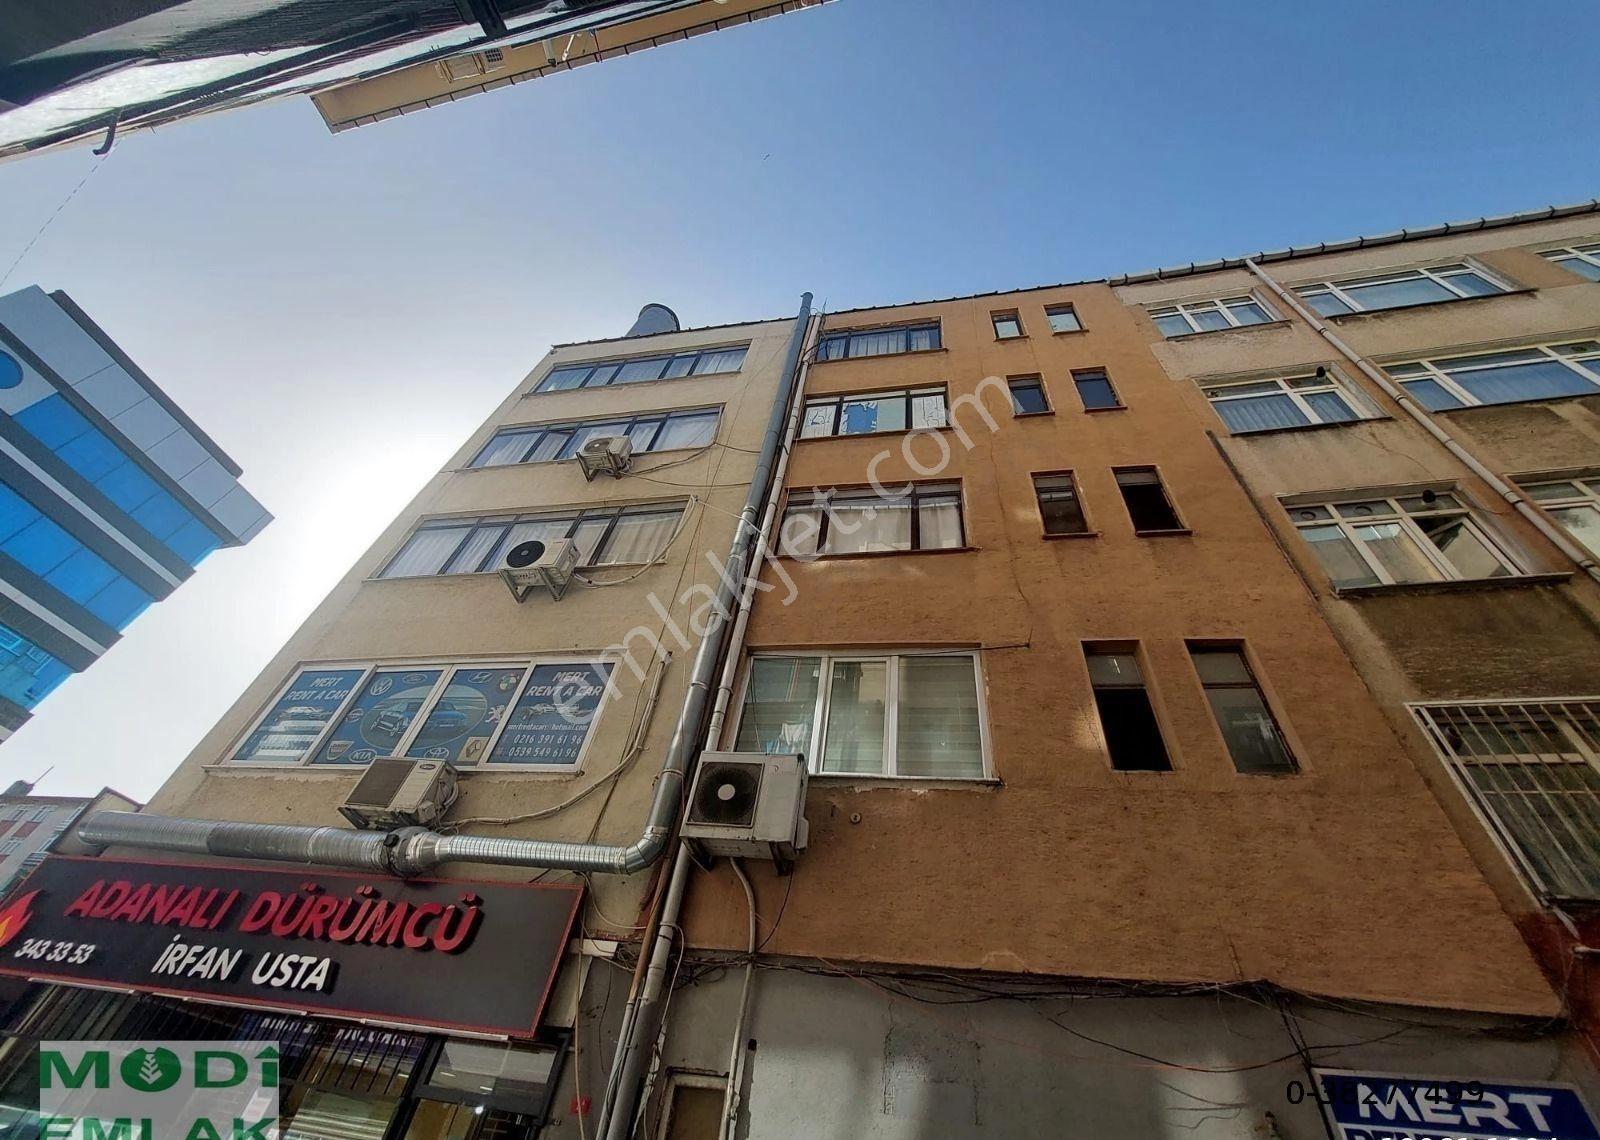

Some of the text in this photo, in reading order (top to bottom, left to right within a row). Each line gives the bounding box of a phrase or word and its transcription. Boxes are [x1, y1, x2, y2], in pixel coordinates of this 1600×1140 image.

[310, 676, 344, 688] MERT
[552, 671, 591, 682] MERT
[284, 690, 314, 701] RENT
[323, 688, 349, 700] CAR
[526, 685, 603, 697] RENT A CAR
[513, 734, 536, 744] 0216
[508, 747, 532, 757] 0539
[64, 880, 483, 952] ADANALI DÜRÜMCÜ
[14, 938, 97, 964] 343 33 53
[151, 933, 333, 991] İRFAN USTA
[1356, 1082, 1553, 1132] MERT
